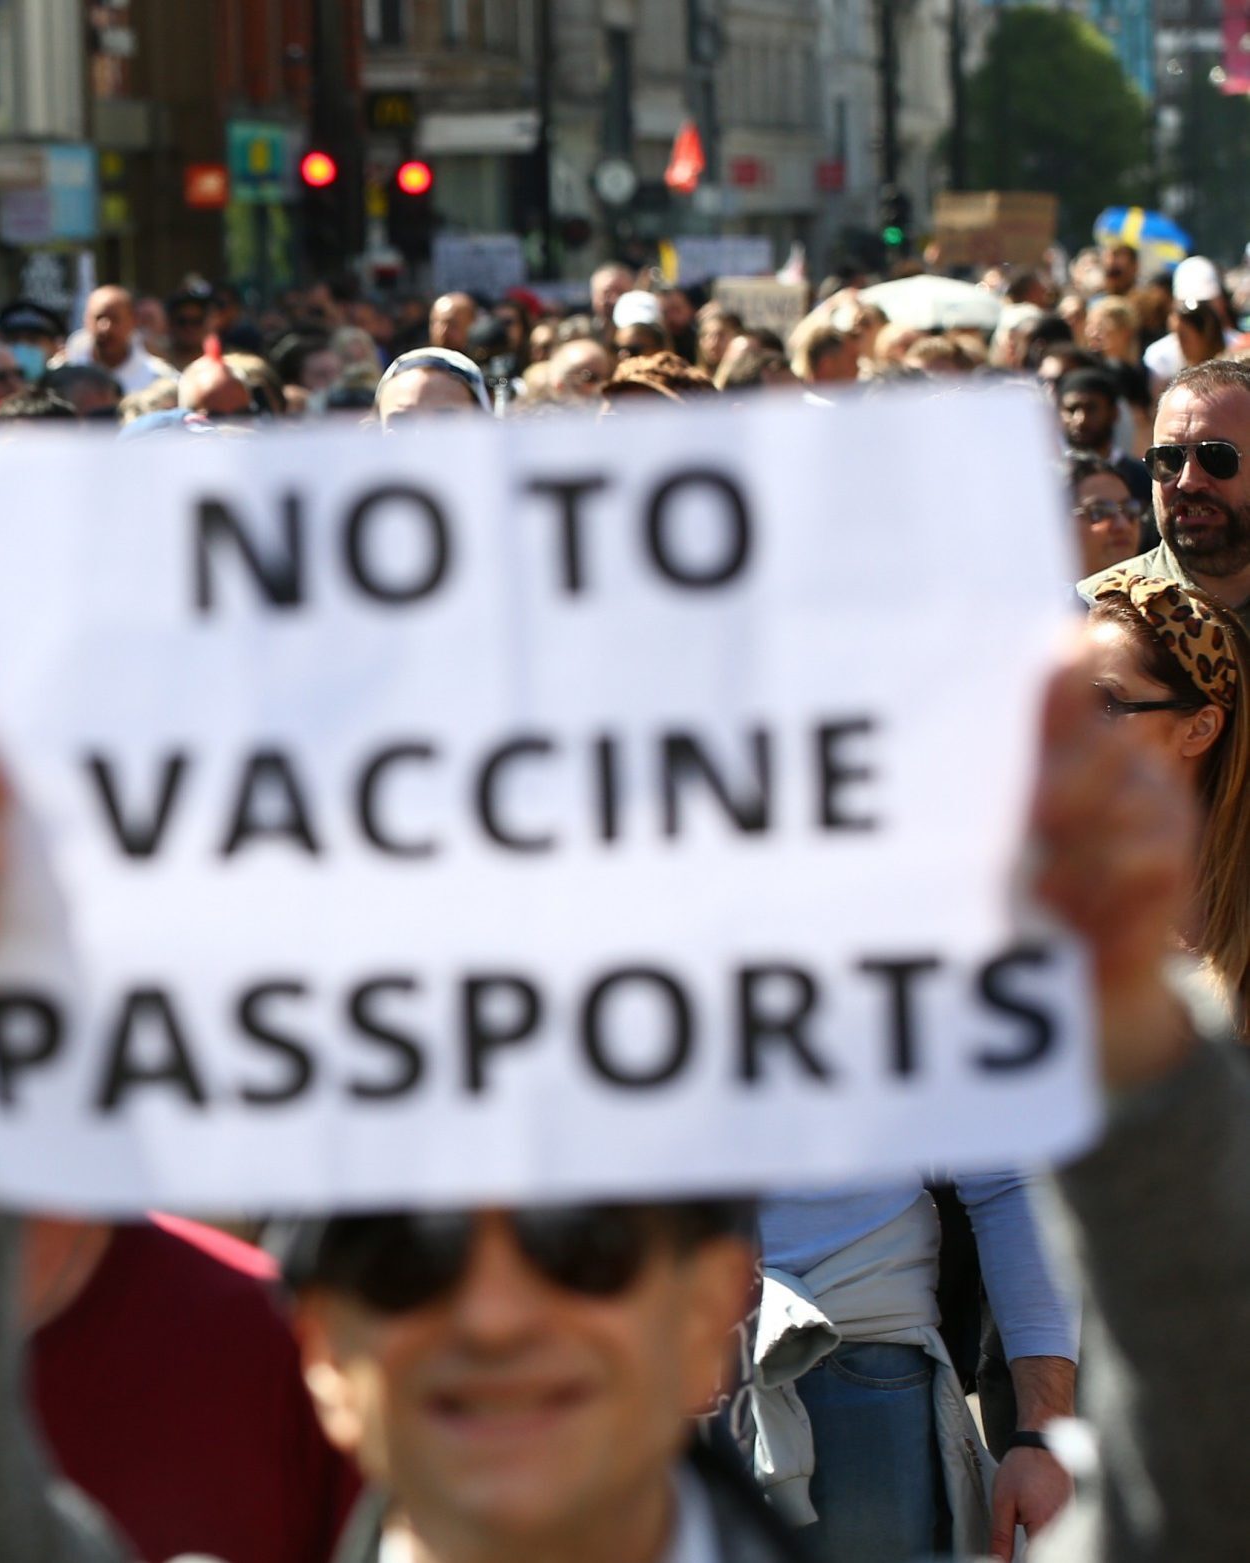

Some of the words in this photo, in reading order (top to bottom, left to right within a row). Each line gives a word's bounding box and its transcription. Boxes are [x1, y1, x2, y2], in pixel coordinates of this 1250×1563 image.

[192, 481, 456, 616] NO
[520, 462, 756, 597] TO
[82, 716, 882, 862] VACCINE
